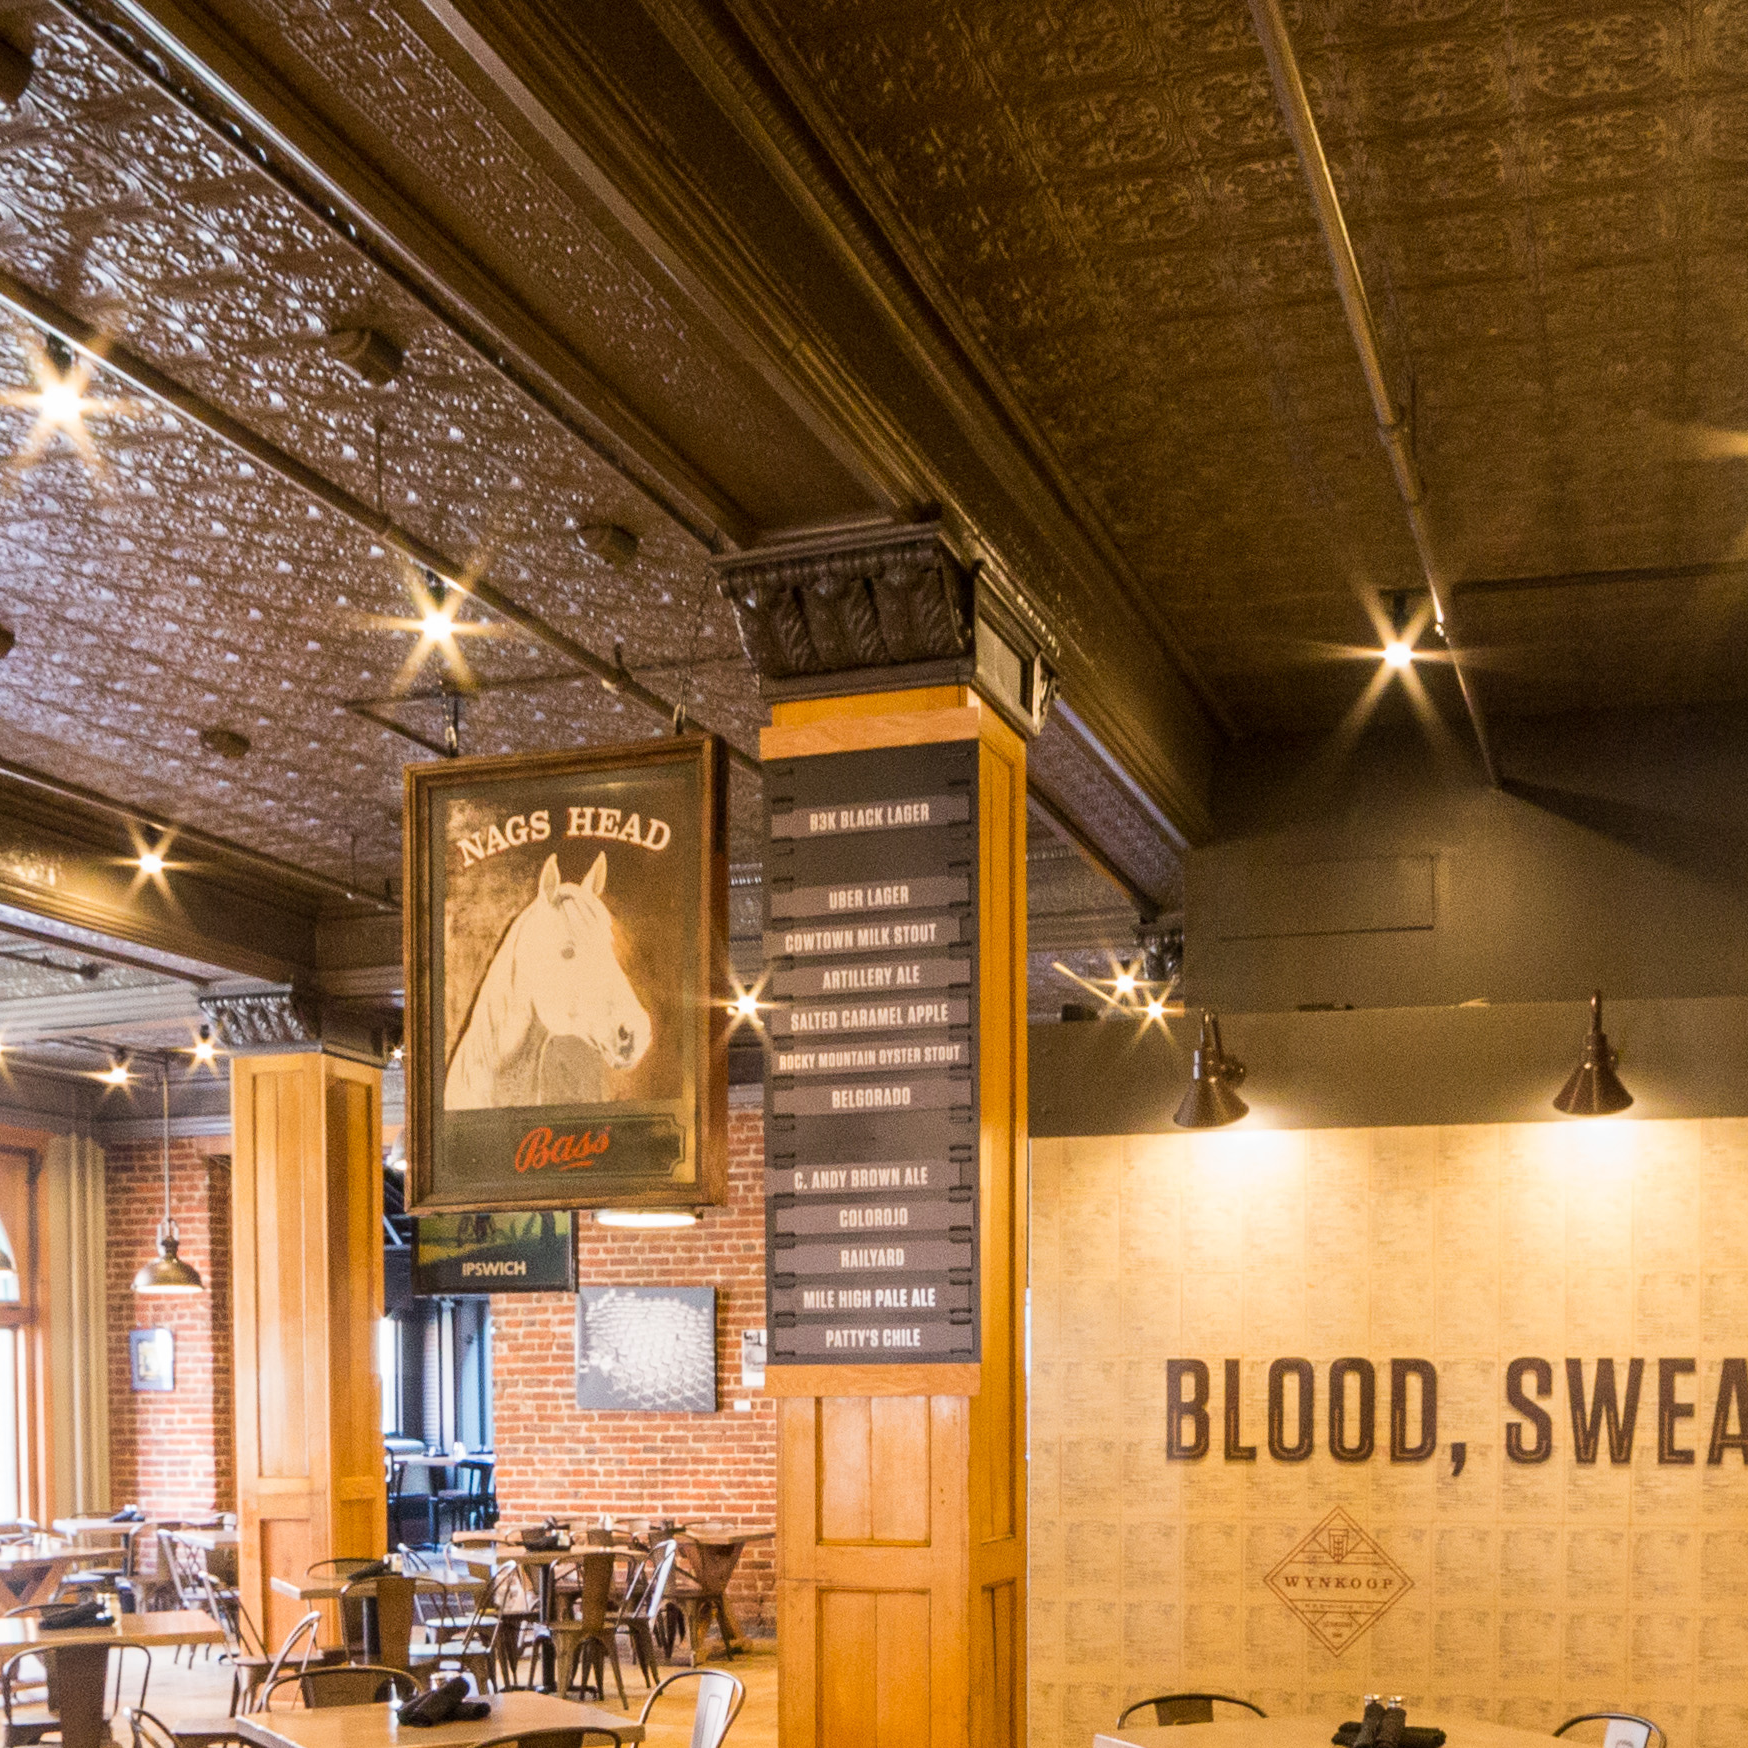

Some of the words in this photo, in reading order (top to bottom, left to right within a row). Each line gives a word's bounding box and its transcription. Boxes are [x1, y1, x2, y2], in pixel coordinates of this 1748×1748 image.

[840, 807, 884, 829] BLACK
[887, 802, 931, 824] LAGER
[455, 810, 552, 869] NAGS
[565, 806, 672, 851] HEAD
[828, 890, 864, 910] UBER
[867, 885, 910, 907] LAGER
[785, 930, 854, 952] COWTOWN
[857, 925, 891, 948] MILK
[894, 922, 938, 945] STOUT
[822, 967, 893, 990] ARTILLERY
[896, 965, 921, 984] ALE
[790, 1010, 838, 1032] SALTED
[841, 1006, 904, 1028] CARAMEL
[907, 1003, 949, 1024] APPLE
[779, 1053, 815, 1071] ROCKY
[818, 1049, 877, 1069] MOUNTAIN
[879, 1047, 921, 1064] OYSTER
[924, 1044, 961, 1062] STOUT
[831, 1086, 912, 1109] BELGORADO
[514, 1126, 611, 1173] Bass
[794, 1171, 808, 1190] C.
[811, 1169, 848, 1189] ANDY
[851, 1167, 901, 1188] BROWN
[904, 1166, 929, 1186] ALE
[839, 1207, 909, 1228] COLOROJO
[461, 1260, 527, 1277] IPSWICH
[840, 1247, 906, 1269] RAILYARD
[803, 1290, 835, 1309] MILE
[838, 1289, 873, 1309] HIGH
[875, 1288, 908, 1308] PALE
[910, 1287, 937, 1308] ALE
[825, 1328, 880, 1349] PATTY'S
[882, 1327, 922, 1347] CHILE
[1165, 1356, 1467, 1477] BLOOD,
[1284, 1575, 1394, 1590] WYNKOOP
